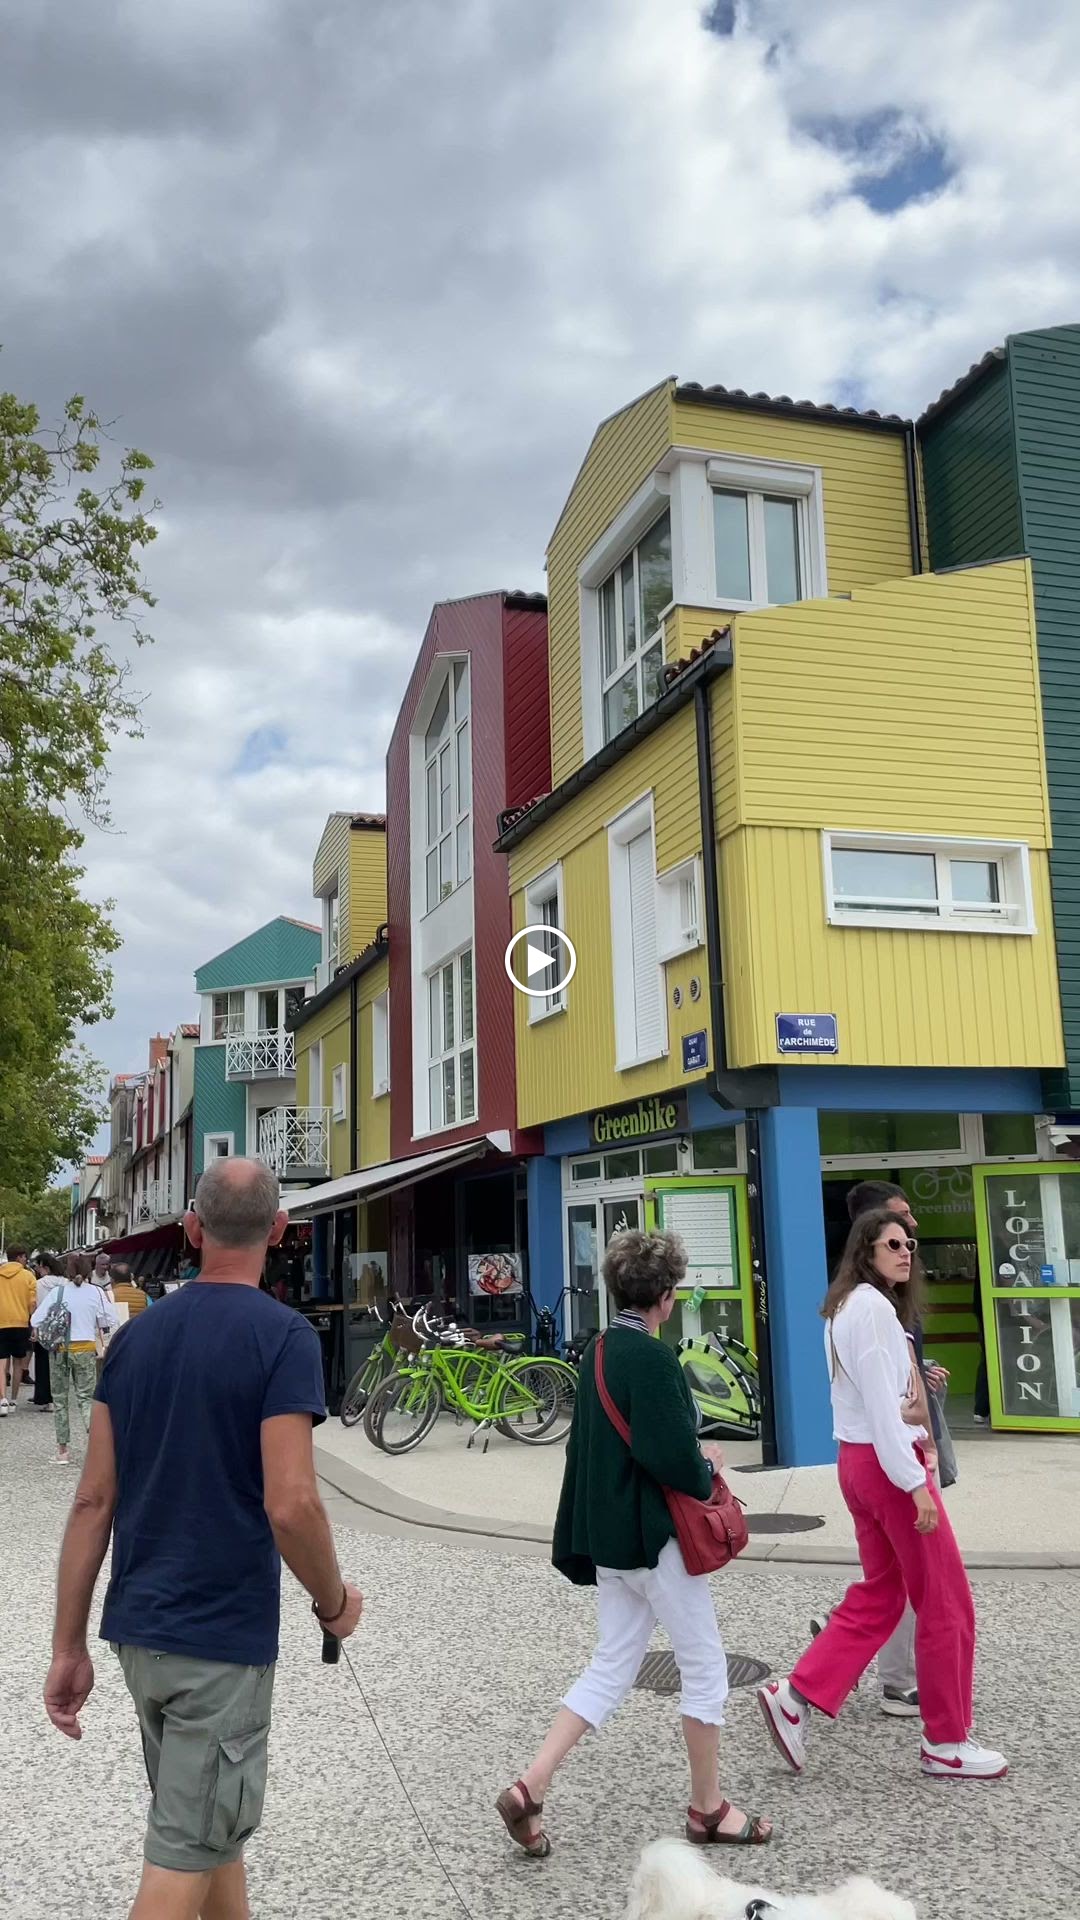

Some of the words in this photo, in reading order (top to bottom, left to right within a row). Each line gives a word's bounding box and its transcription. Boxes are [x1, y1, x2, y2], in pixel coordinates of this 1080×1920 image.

[797, 1018, 816, 1026] RUE
[593, 1097, 677, 1144] Greenbike
[1003, 1189, 1045, 1401] LOCATION
